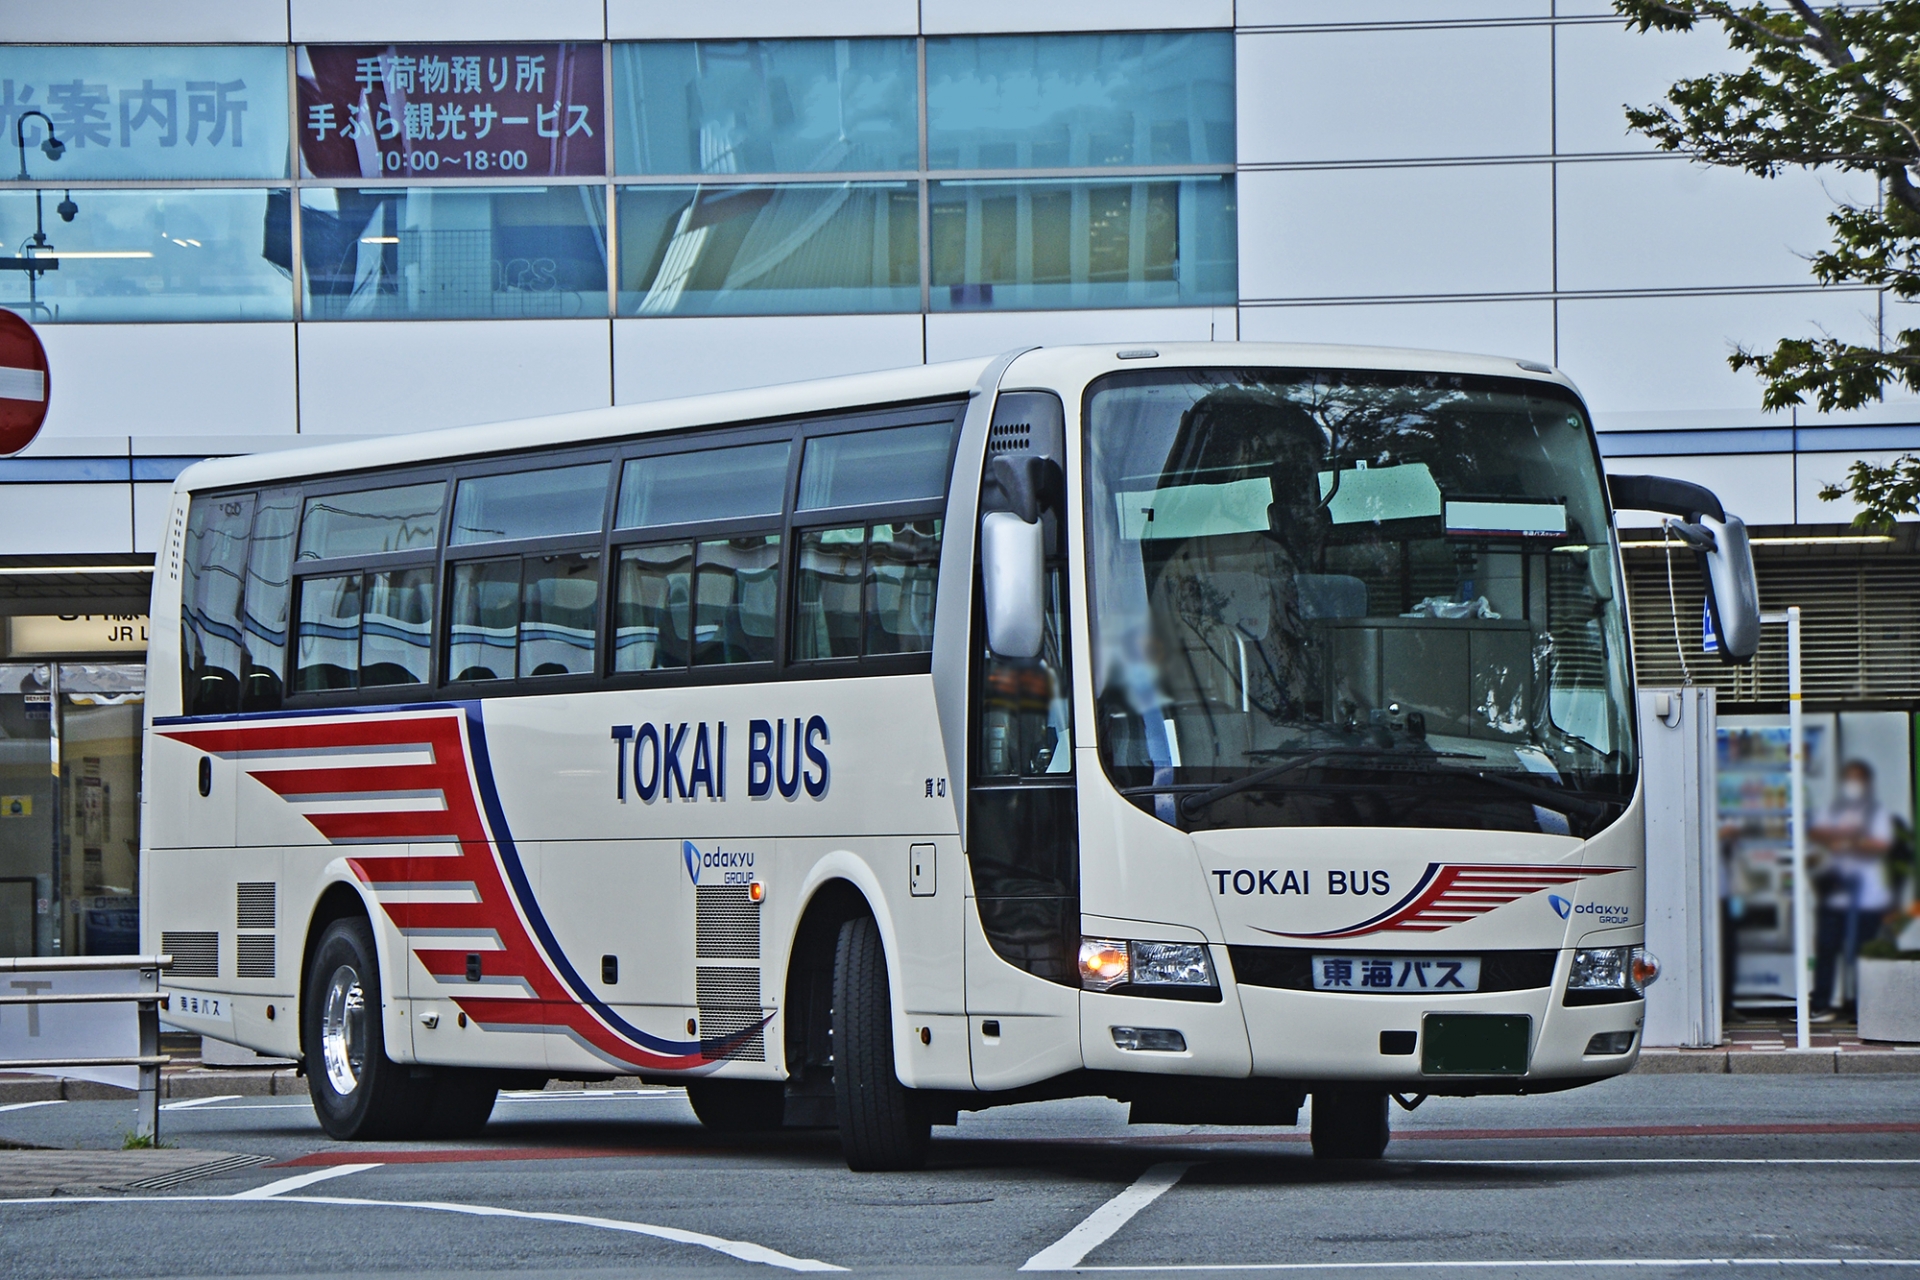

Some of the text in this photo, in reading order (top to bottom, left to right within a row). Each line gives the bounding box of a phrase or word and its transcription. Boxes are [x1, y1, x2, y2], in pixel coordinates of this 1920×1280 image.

[354, 54, 546, 94] 手荷物預り所
[0, 78, 248, 148] 光案内所
[307, 100, 594, 141] 手ぶら観光サービス
[108, 626, 133, 642] JR
[611, 714, 831, 805] TOKAI BUS
[724, 871, 755, 884] GROUP
[1211, 869, 1391, 896] TOKAI BUS
[1599, 915, 1629, 924] GROUP
[1322, 958, 1466, 988] 東海バス
